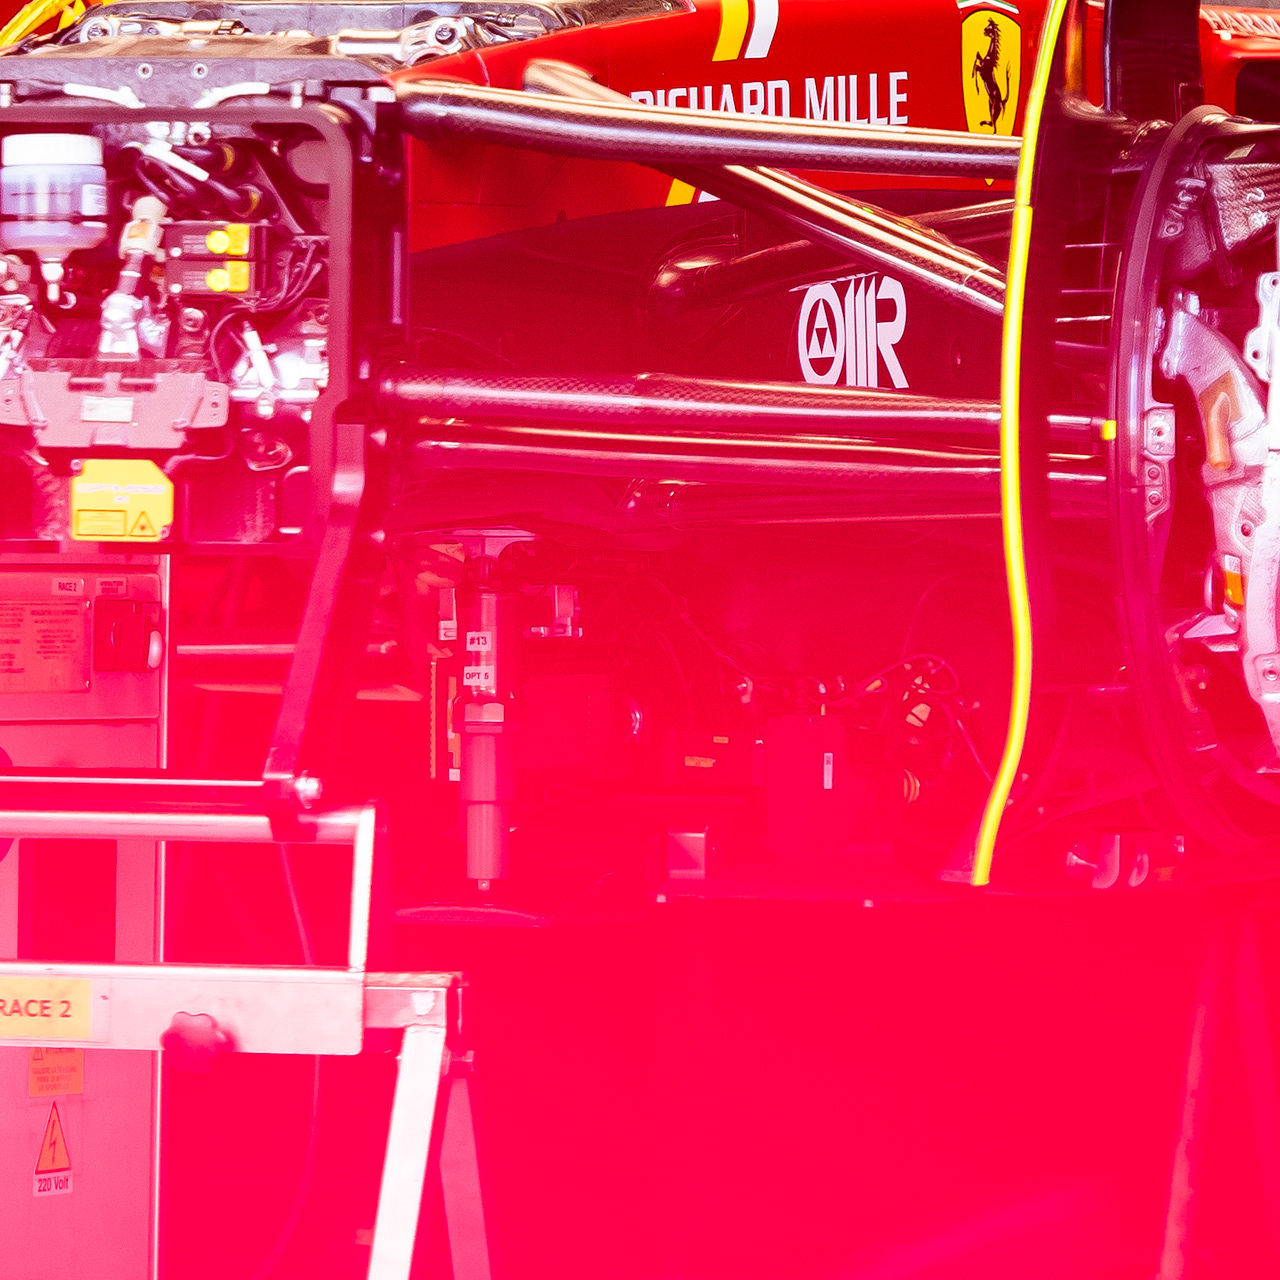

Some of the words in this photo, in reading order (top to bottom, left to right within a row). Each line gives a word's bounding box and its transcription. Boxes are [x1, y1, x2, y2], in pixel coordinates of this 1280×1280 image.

[804, 71, 908, 124] MILLE
[469, 636, 487, 645] #13
[465, 672, 481, 680] OPT
[59, 1000, 72, 1018] 2
[37, 1177, 51, 1192] 220
[53, 1175, 69, 1190] Volt
